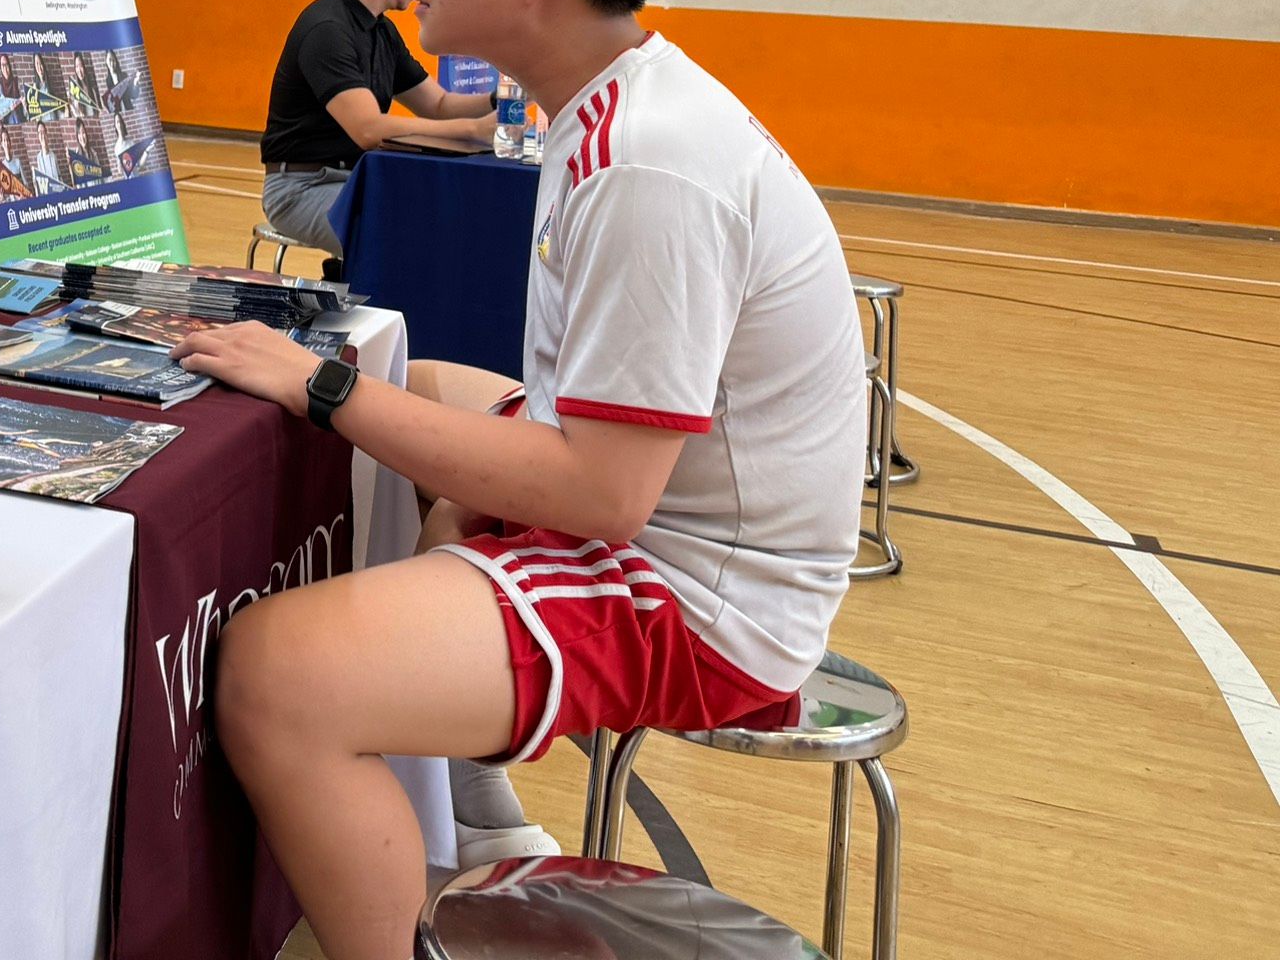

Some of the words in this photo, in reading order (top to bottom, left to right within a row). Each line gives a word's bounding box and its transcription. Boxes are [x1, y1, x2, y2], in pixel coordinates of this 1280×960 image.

[6, 30, 33, 44] Alumni
[33, 30, 68, 48] Spotlight
[19, 203, 59, 225] University
[58, 196, 90, 216] Transfer
[89, 191, 122, 210] Program
[28, 240, 49, 254] Recent
[48, 232, 78, 252] graduates
[77, 226, 103, 243] accepted
